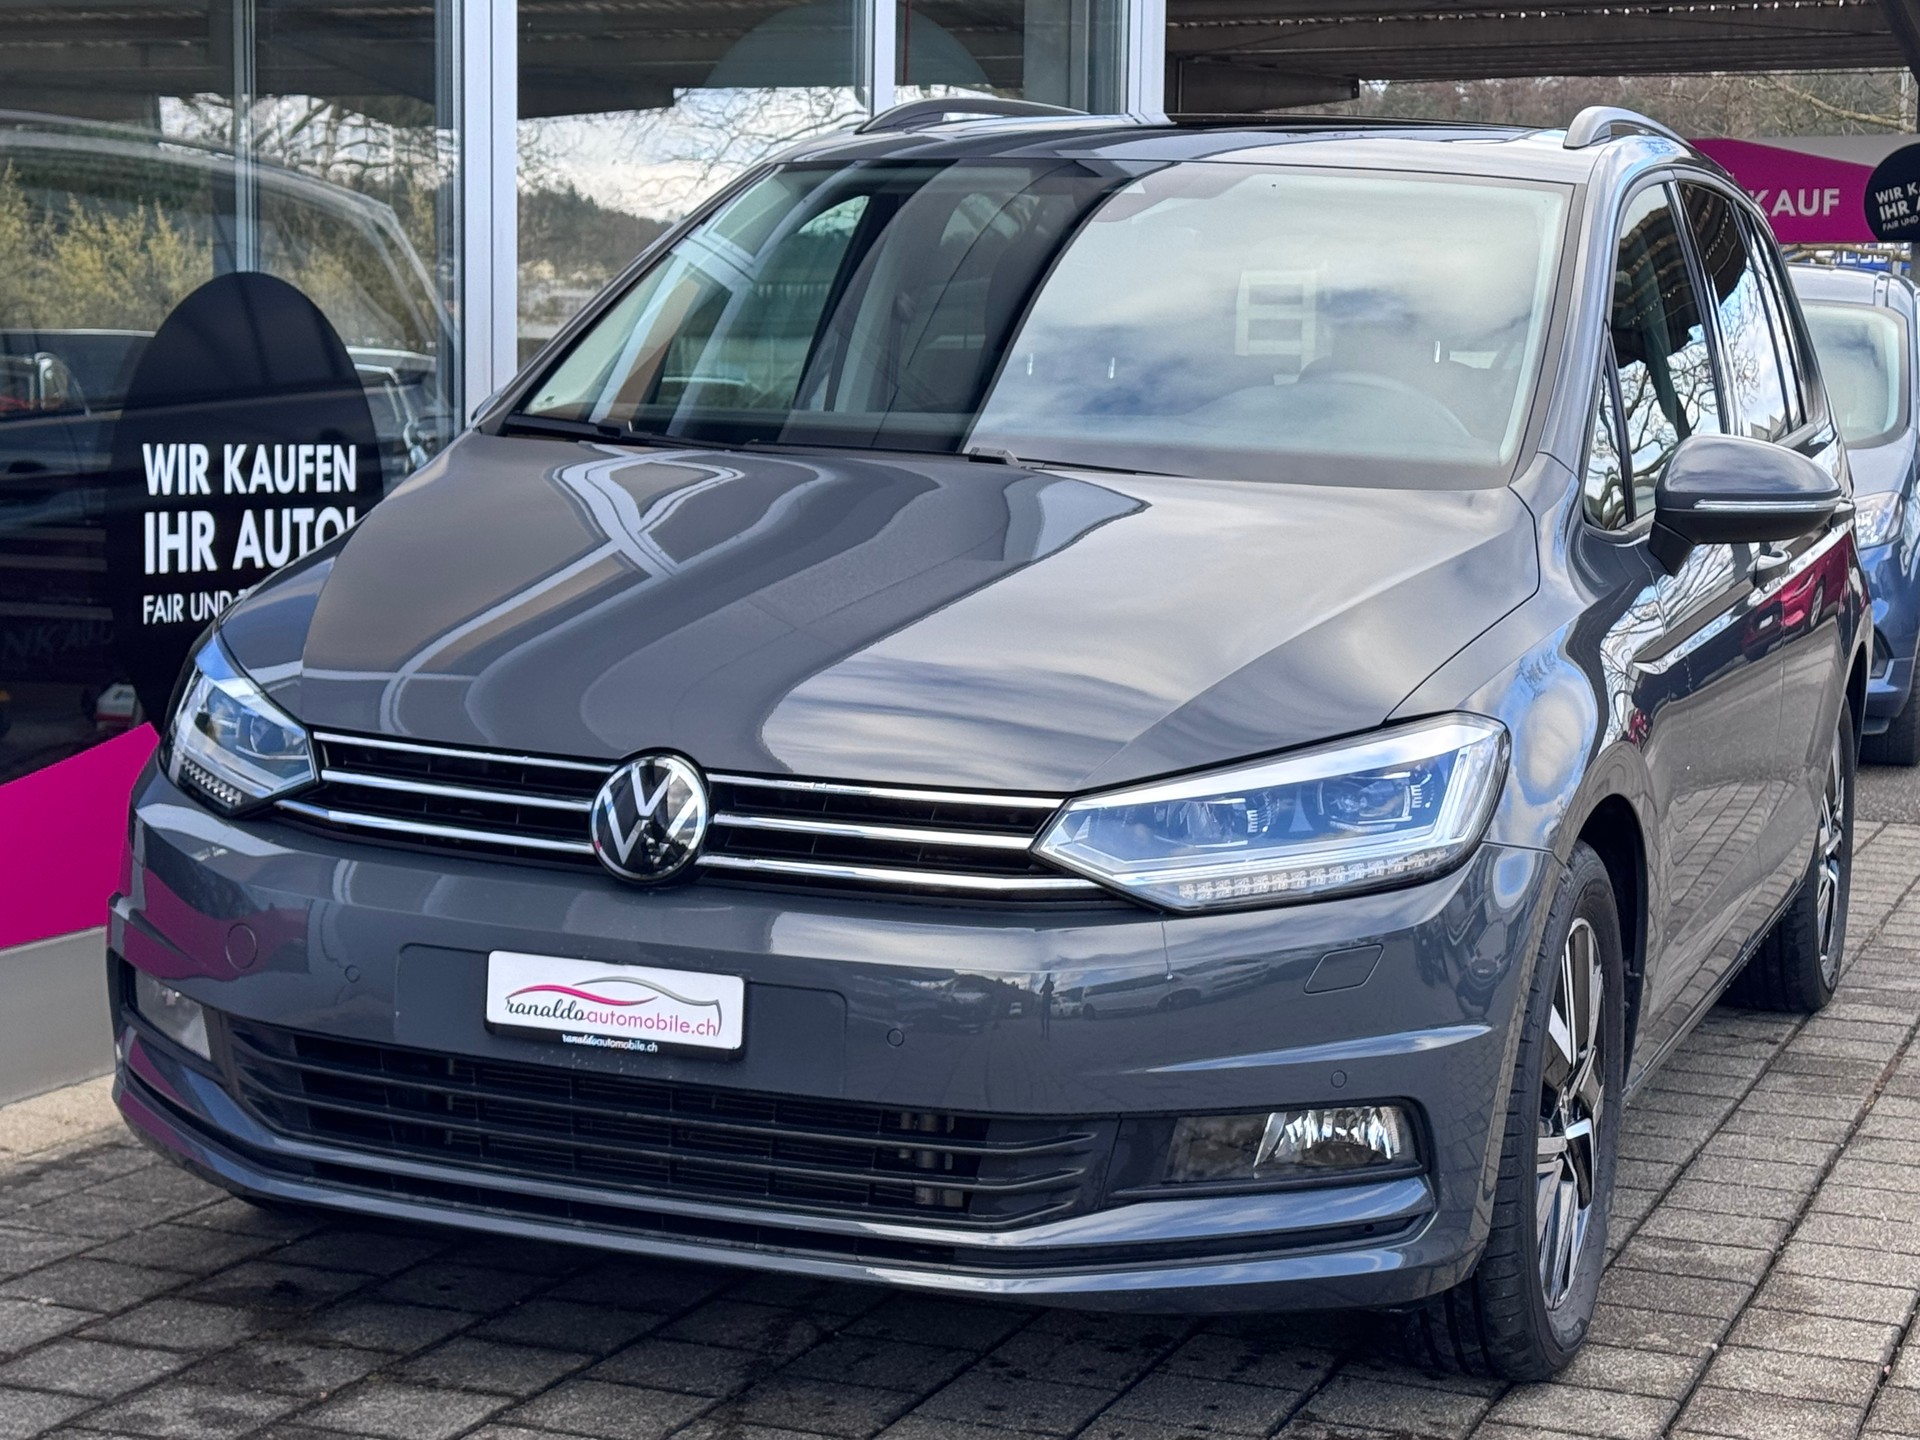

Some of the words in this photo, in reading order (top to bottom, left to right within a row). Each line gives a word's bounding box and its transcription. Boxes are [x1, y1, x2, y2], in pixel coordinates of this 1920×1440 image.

[1875, 186, 1904, 204] WIR
[1879, 200, 1910, 221] IHR
[142, 443, 211, 496] WIR
[223, 443, 357, 495] KAUFEN
[144, 510, 218, 575] IHR
[143, 594, 184, 625] FAIR
